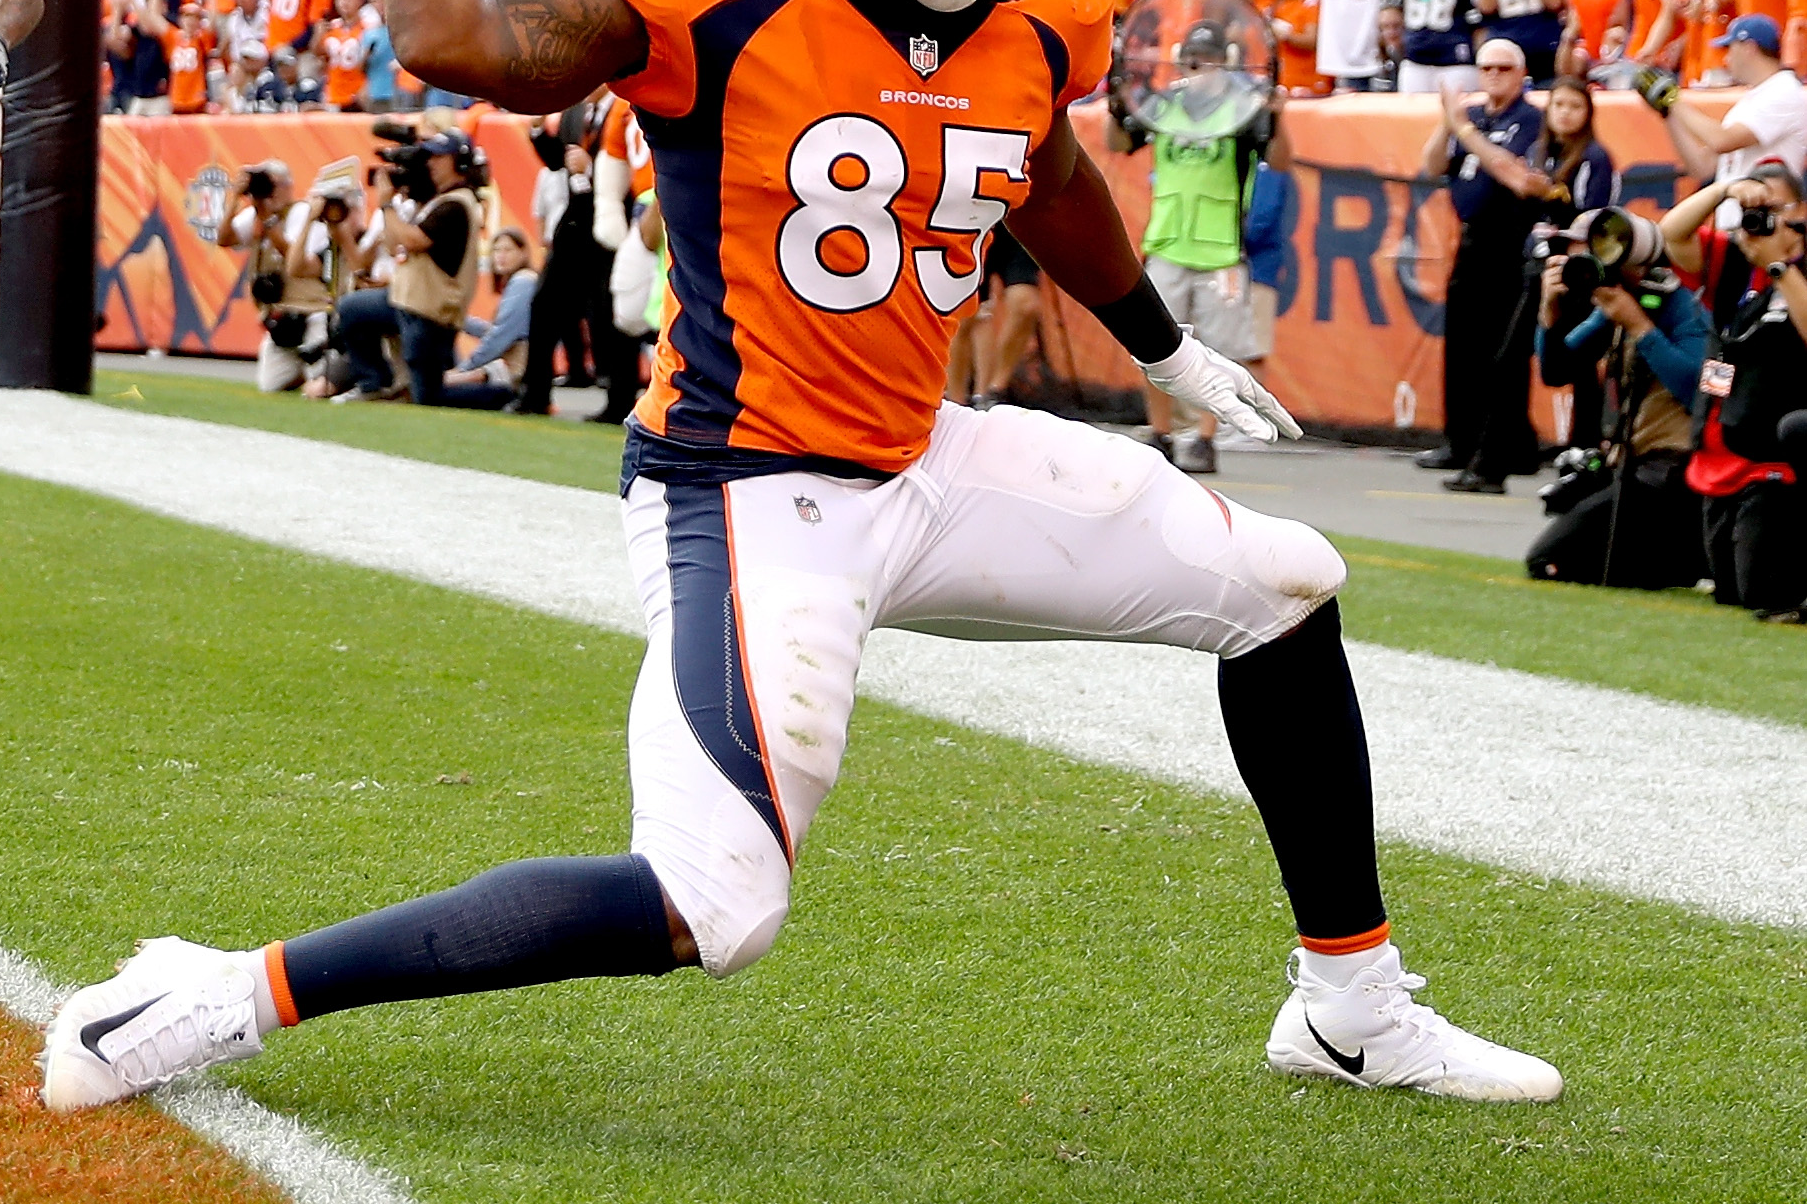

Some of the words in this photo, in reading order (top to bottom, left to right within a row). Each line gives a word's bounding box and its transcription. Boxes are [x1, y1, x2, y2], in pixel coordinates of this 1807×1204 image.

[914, 51, 935, 69] NFL
[879, 90, 971, 111] BRONCOS
[775, 112, 1030, 316] 85
